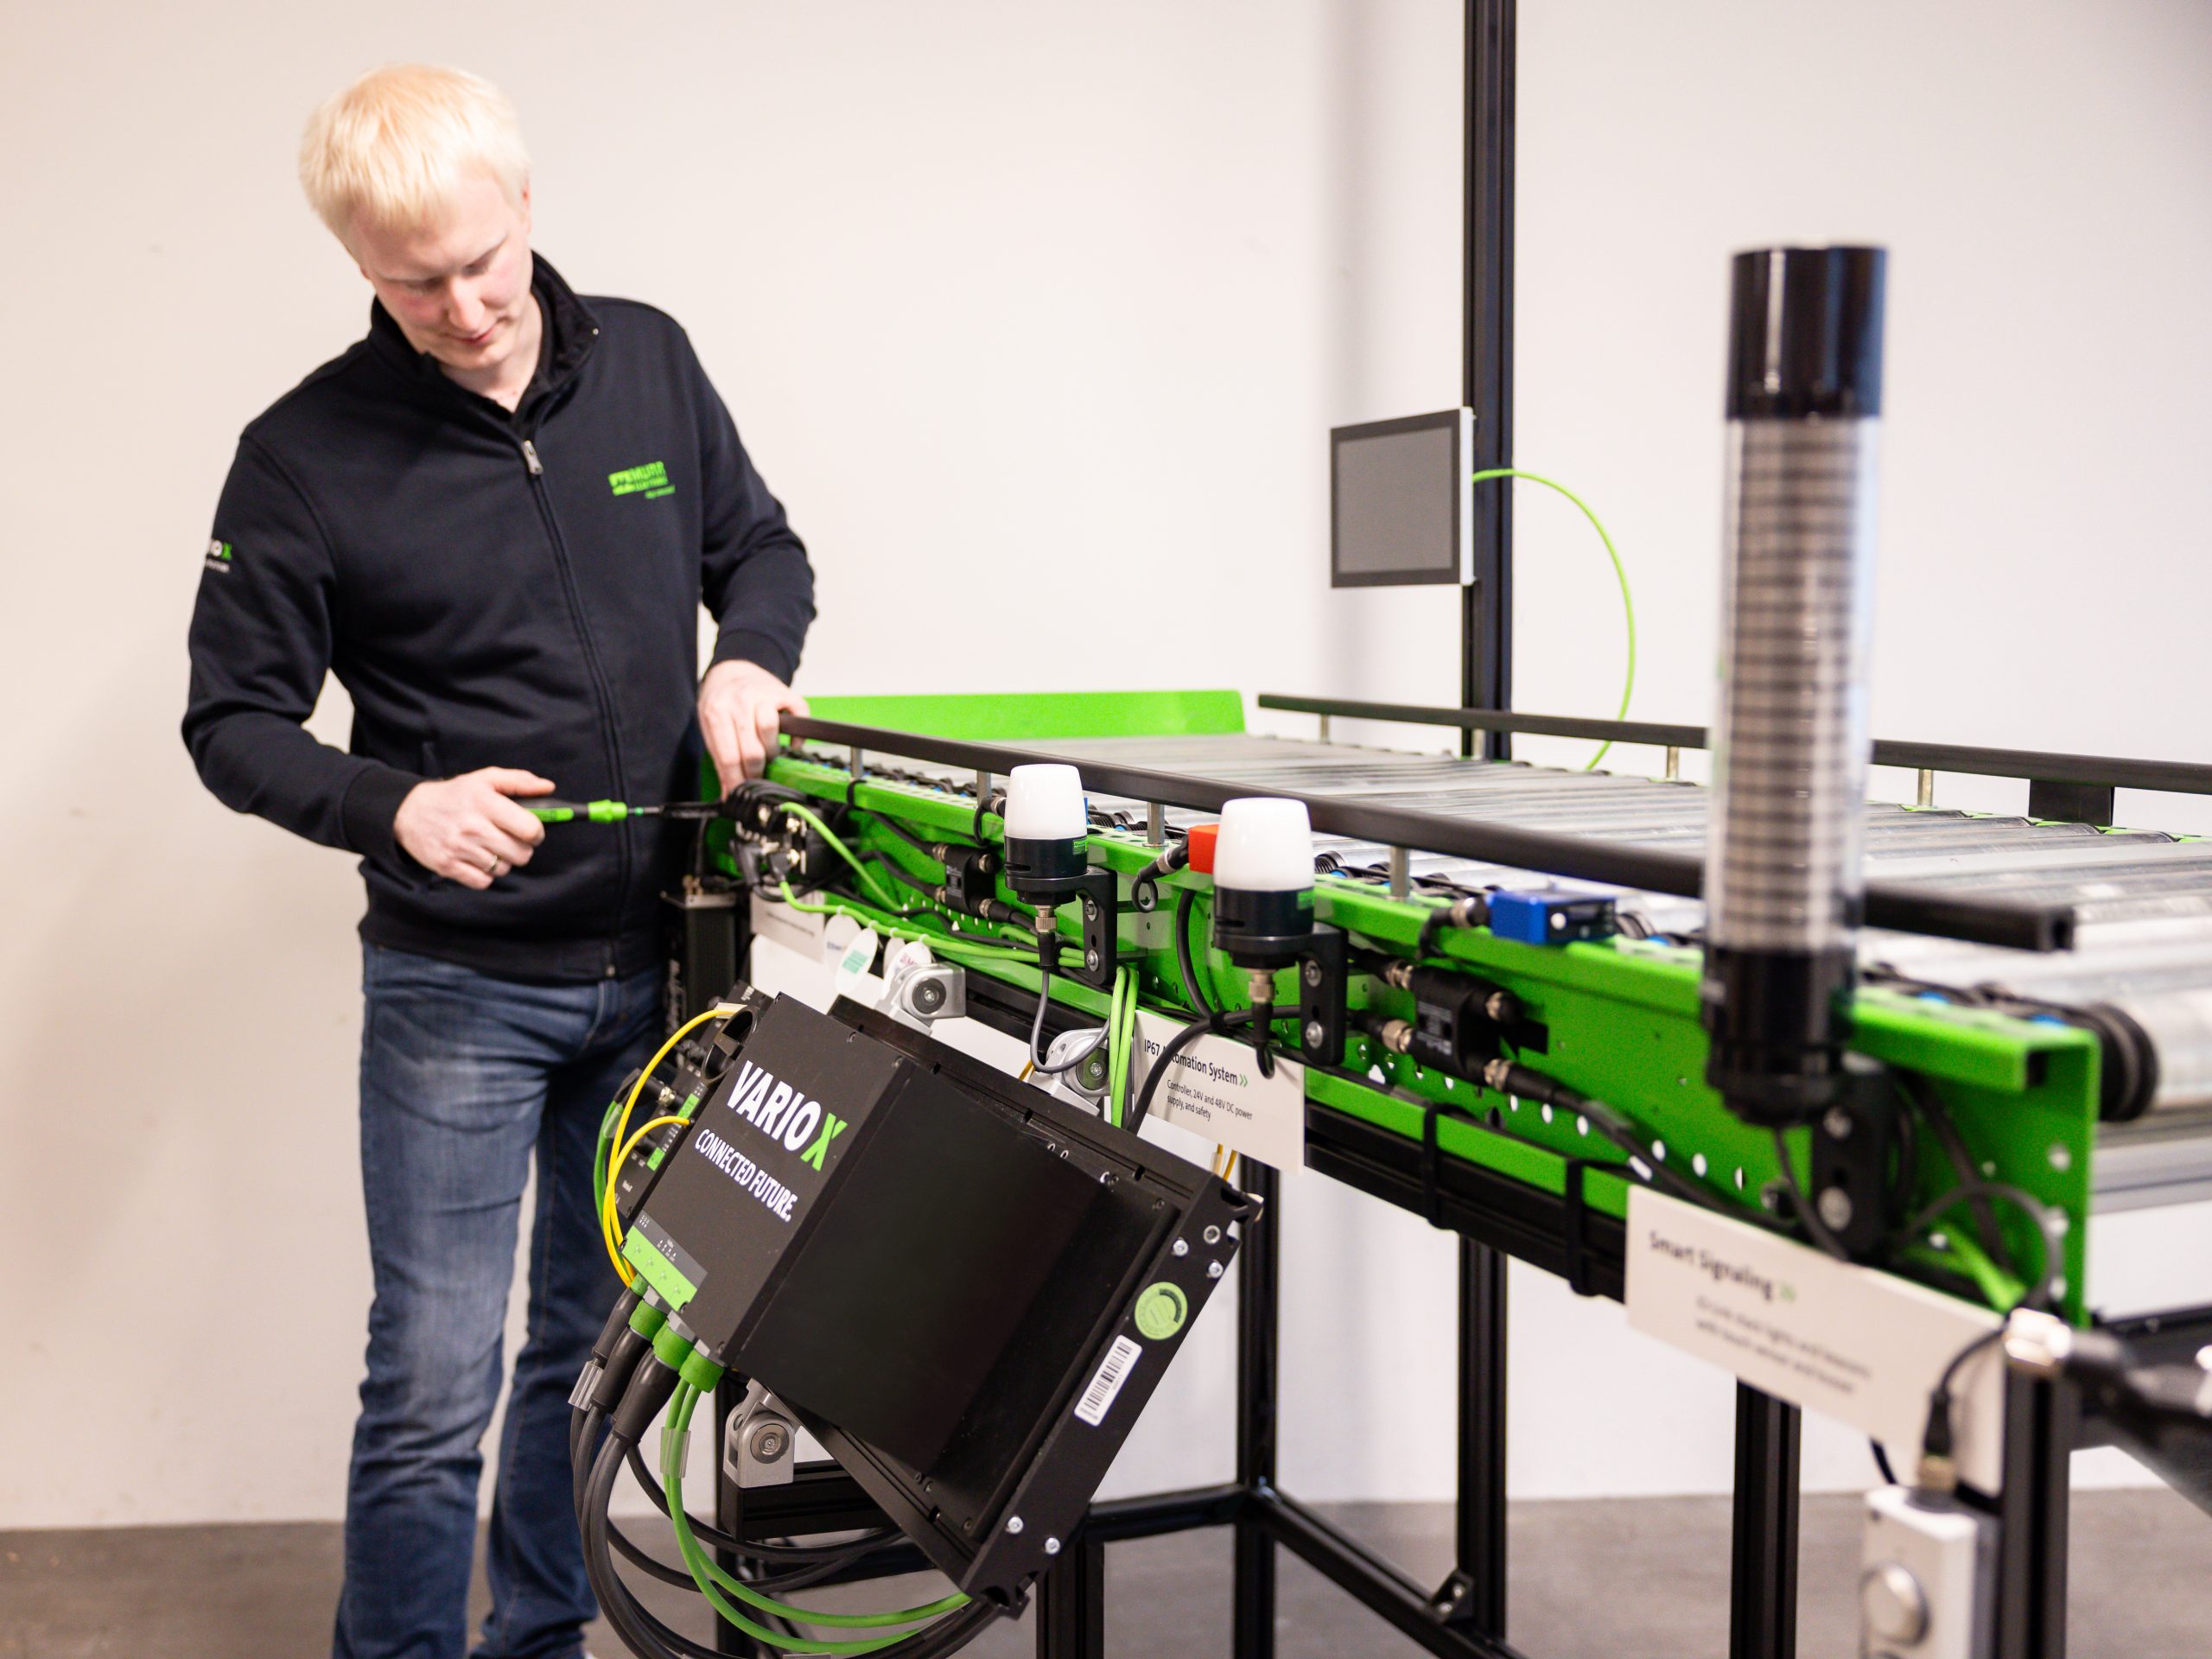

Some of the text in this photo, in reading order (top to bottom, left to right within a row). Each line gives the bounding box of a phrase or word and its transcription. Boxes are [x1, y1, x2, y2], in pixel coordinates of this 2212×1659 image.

[1144, 1039, 1160, 1057] IP67
[1209, 1062, 1238, 1085] System
[1166, 1079, 1253, 1121] Controller, 24V and 48V DC power
[1166, 1094, 1211, 1122] supply, and safety
[695, 1128, 798, 1223] CONNECTED FUTURE.
[1649, 1229, 1695, 1265] Smart
